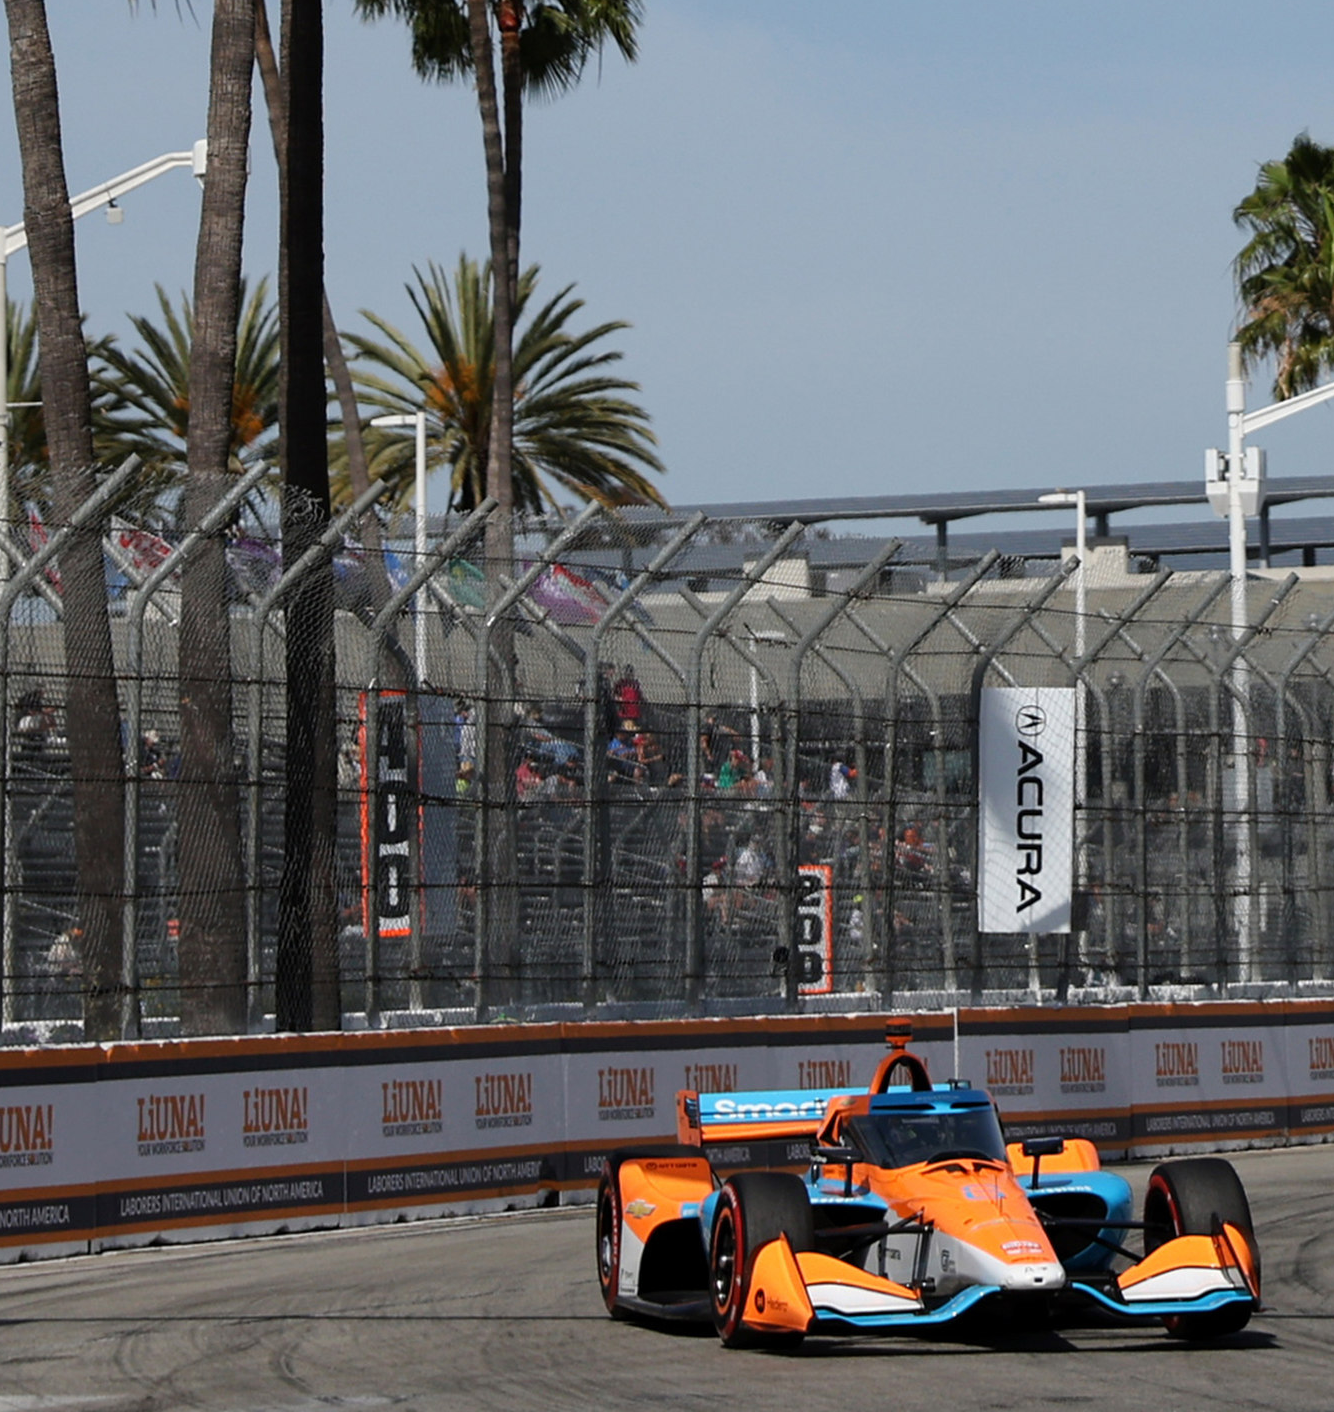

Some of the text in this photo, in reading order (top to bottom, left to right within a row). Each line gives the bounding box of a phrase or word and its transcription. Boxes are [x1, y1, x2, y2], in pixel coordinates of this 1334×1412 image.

[1017, 739, 1044, 914] ACURA
[797, 874, 823, 984] 200
[986, 1049, 1035, 1085] LiUNA!
[1059, 1047, 1106, 1083] LiUNA!
[1155, 1042, 1199, 1077] LiUNA!
[1221, 1040, 1263, 1074] LiUNA!
[382, 1079, 442, 1124] LiUNA!
[475, 1073, 532, 1117] LiUNA!
[598, 1066, 655, 1108] LiUNA!
[137, 1094, 205, 1142] LiUNA!
[243, 1087, 308, 1134] LiUNA!
[0, 1209, 30, 1229] NORTH
[31, 1206, 69, 1226] AMERICA
